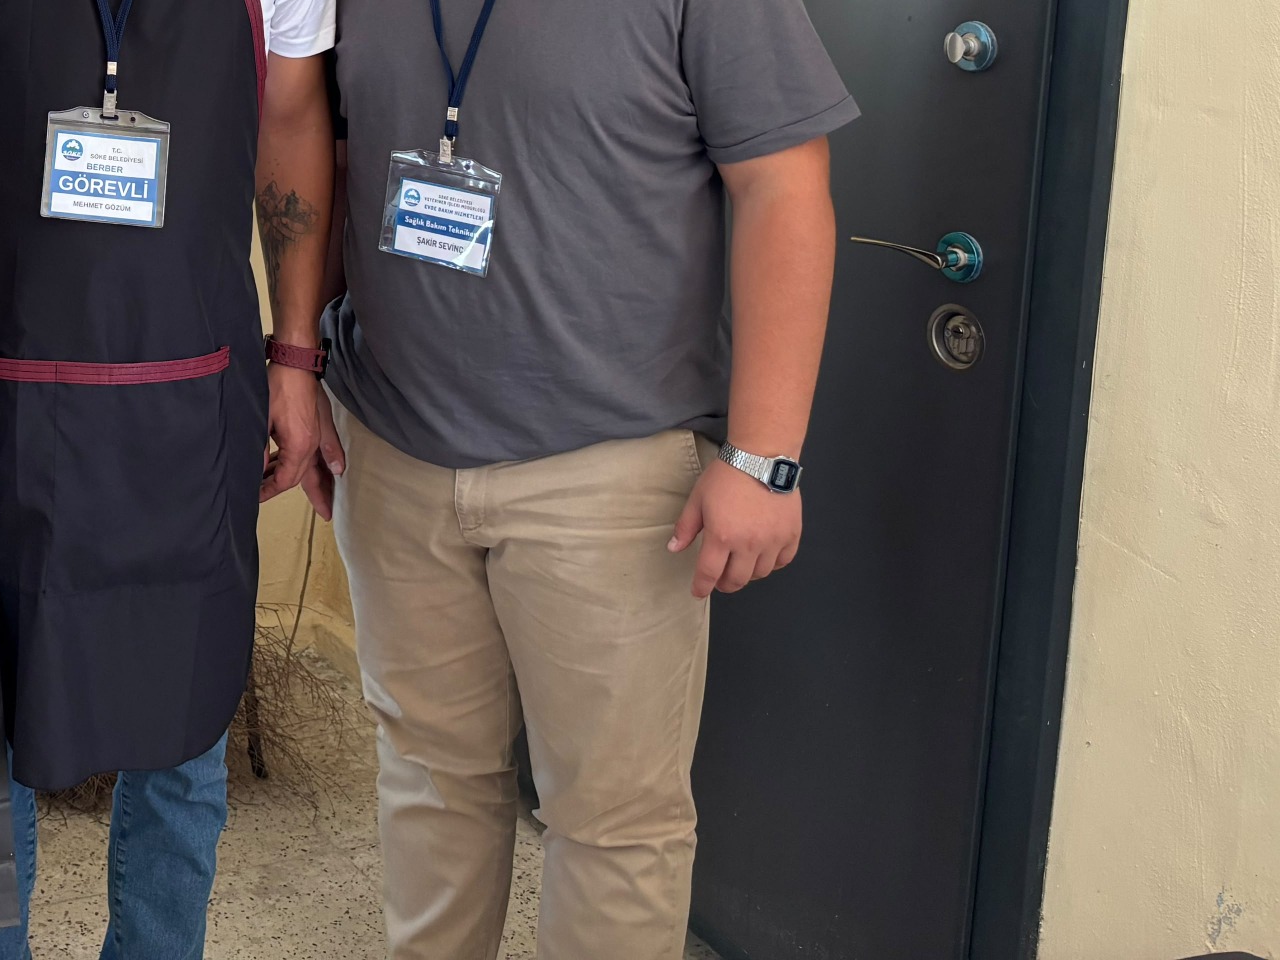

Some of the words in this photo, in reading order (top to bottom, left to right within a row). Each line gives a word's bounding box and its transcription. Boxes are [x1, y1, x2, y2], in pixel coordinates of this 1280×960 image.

[87, 163, 123, 173] BERBER
[59, 174, 148, 198] GÖREVLİ
[405, 216, 424, 226] Sağlık
[426, 220, 446, 231] Bakım
[417, 236, 437, 247] ŞAKİR
